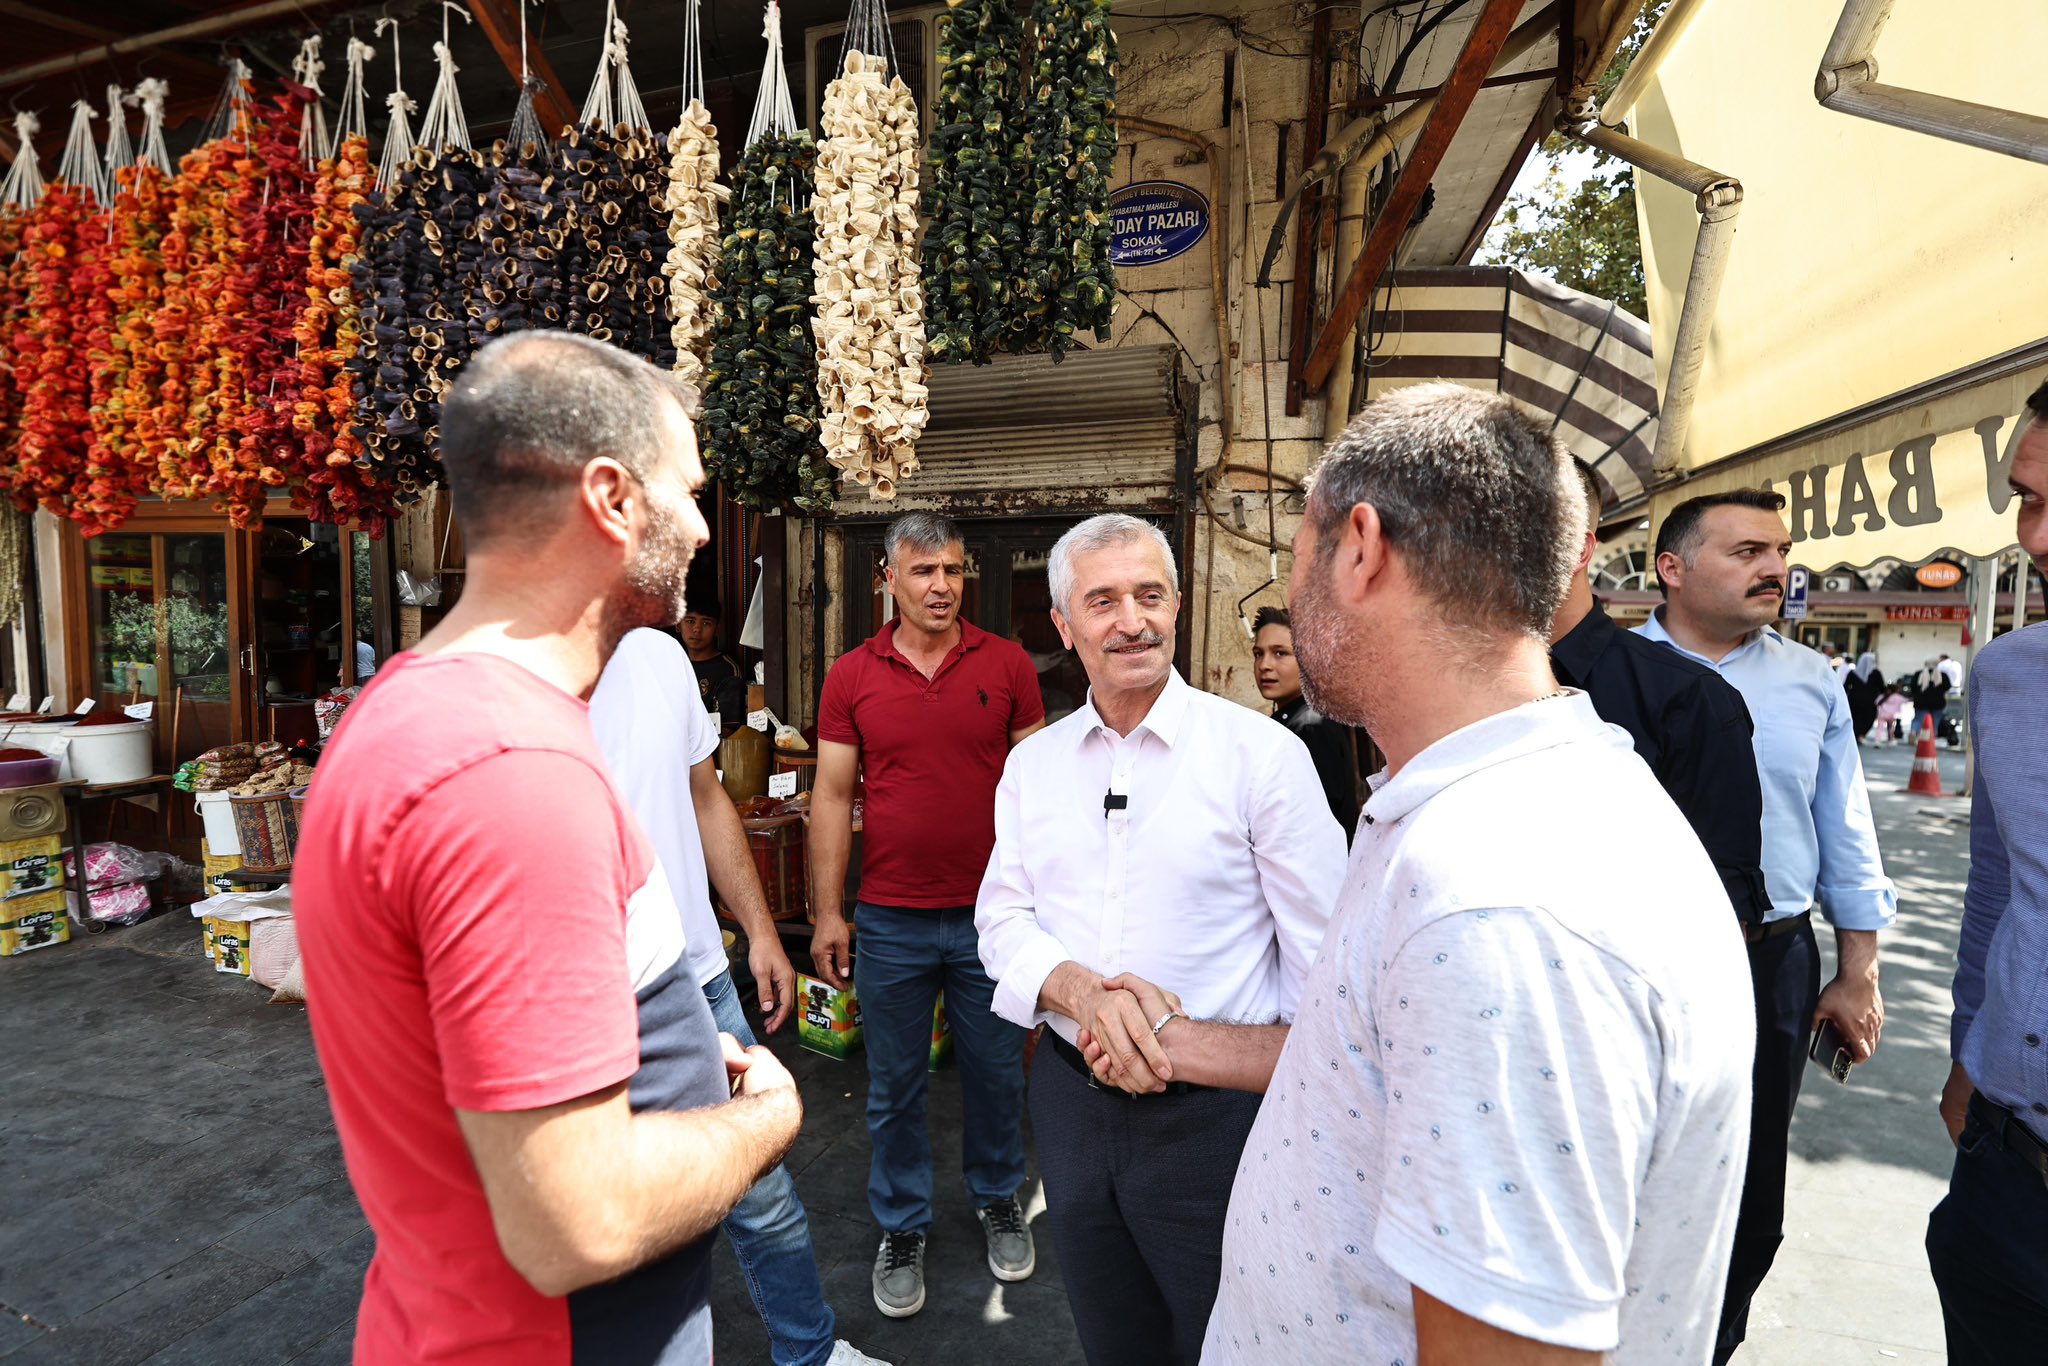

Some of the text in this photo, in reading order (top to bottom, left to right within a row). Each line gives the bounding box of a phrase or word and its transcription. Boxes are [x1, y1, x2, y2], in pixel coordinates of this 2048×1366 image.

[1145, 200, 1180, 211] MAHALLESİ
[1110, 210, 1199, 236] DAY PAZARI
[1121, 234, 1163, 249] SOKAK
[1790, 570, 1807, 598] P
[14, 856, 48, 869] Loras
[214, 876, 231, 886] Loras
[20, 913, 53, 927] Loras
[220, 936, 238, 946] Loras
[807, 1013, 830, 1029] Loras
